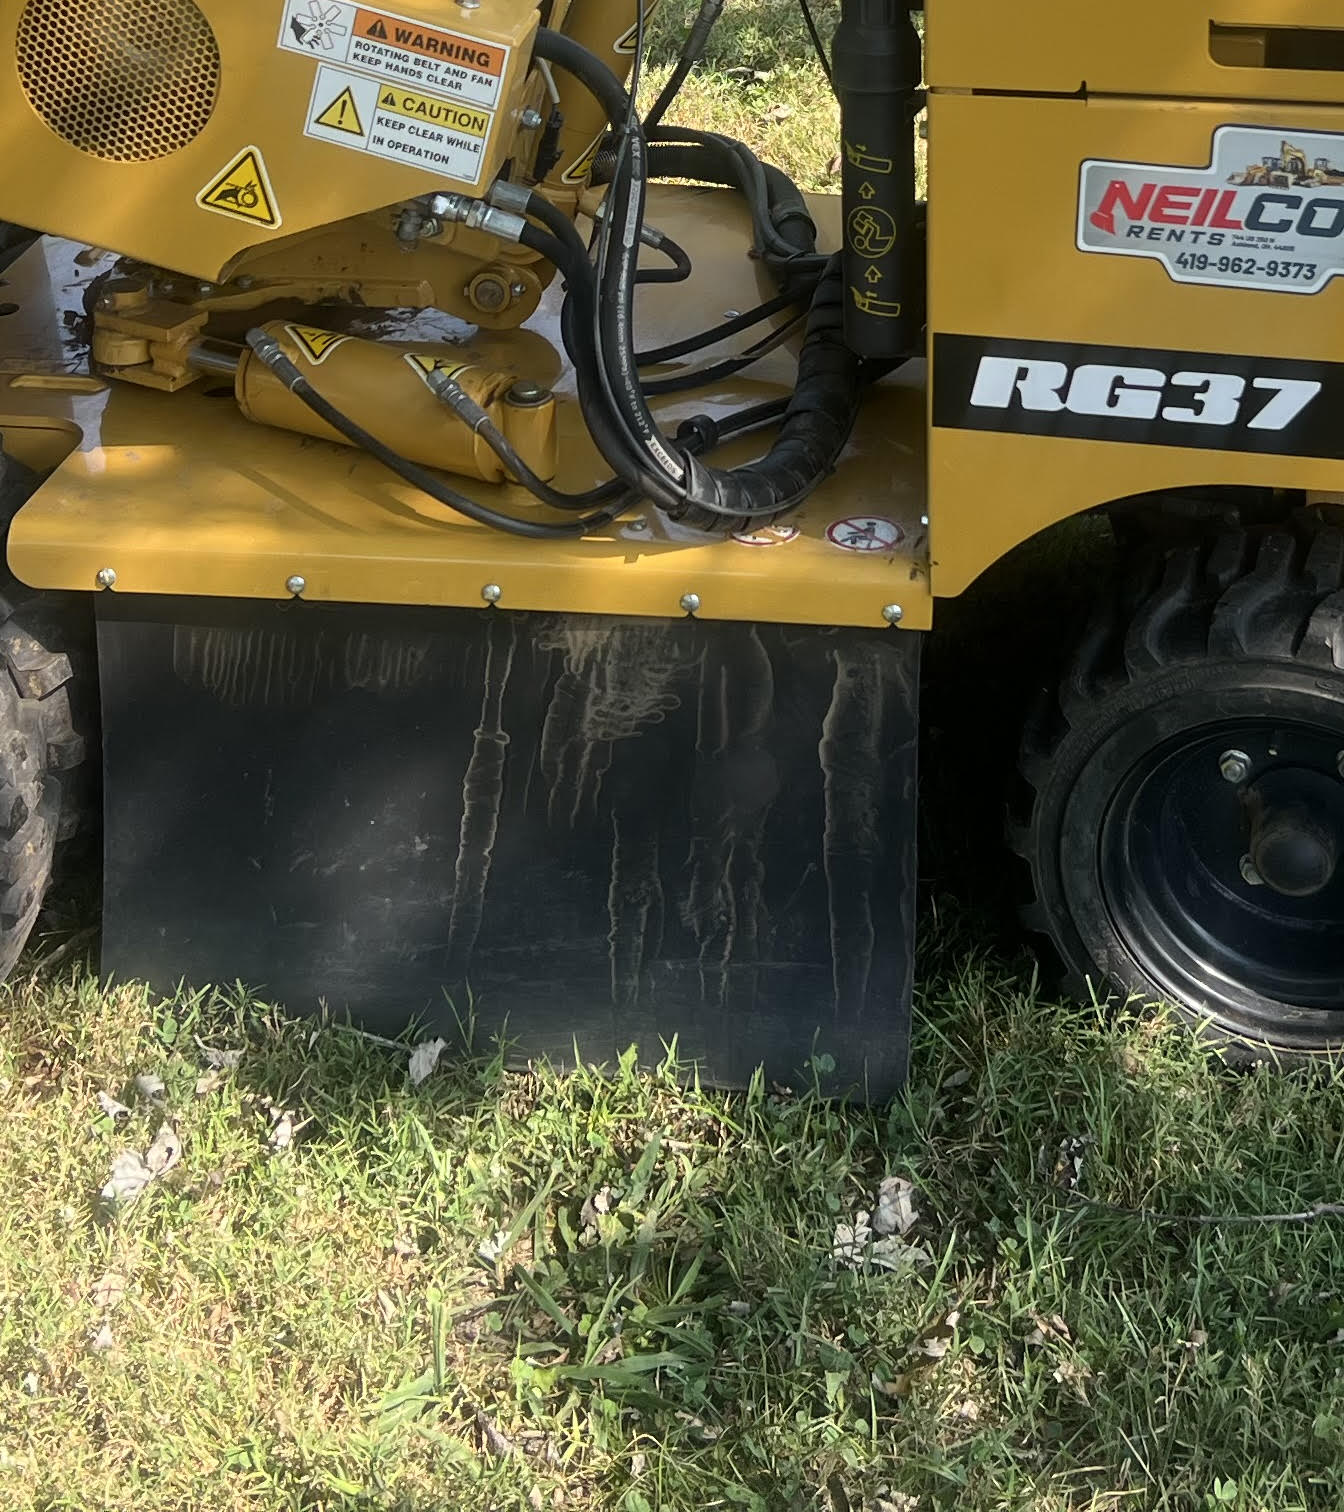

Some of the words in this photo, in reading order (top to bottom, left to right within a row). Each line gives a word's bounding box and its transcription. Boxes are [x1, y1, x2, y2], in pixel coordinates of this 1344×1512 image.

[354, 41, 410, 63] ROTATING
[413, 58, 442, 72] BELT
[444, 66, 468, 80] AND
[471, 74, 493, 88] FAN
[394, 28, 491, 68] WARNING
[352, 53, 382, 70] KEEP
[385, 61, 423, 80] HANDS
[426, 73, 463, 91] CLEAR
[402, 97, 486, 132] CAUTION
[372, 135, 385, 146] IN
[387, 139, 450, 165] OPERATION
[376, 116, 406, 131] KEEP
[408, 124, 443, 143] CLEAR
[446, 136, 481, 154] WHILE
[1126, 225, 1226, 247] RENTS
[1175, 251, 1318, 280] 419-962-9373
[970, 355, 1322, 430] RG37
